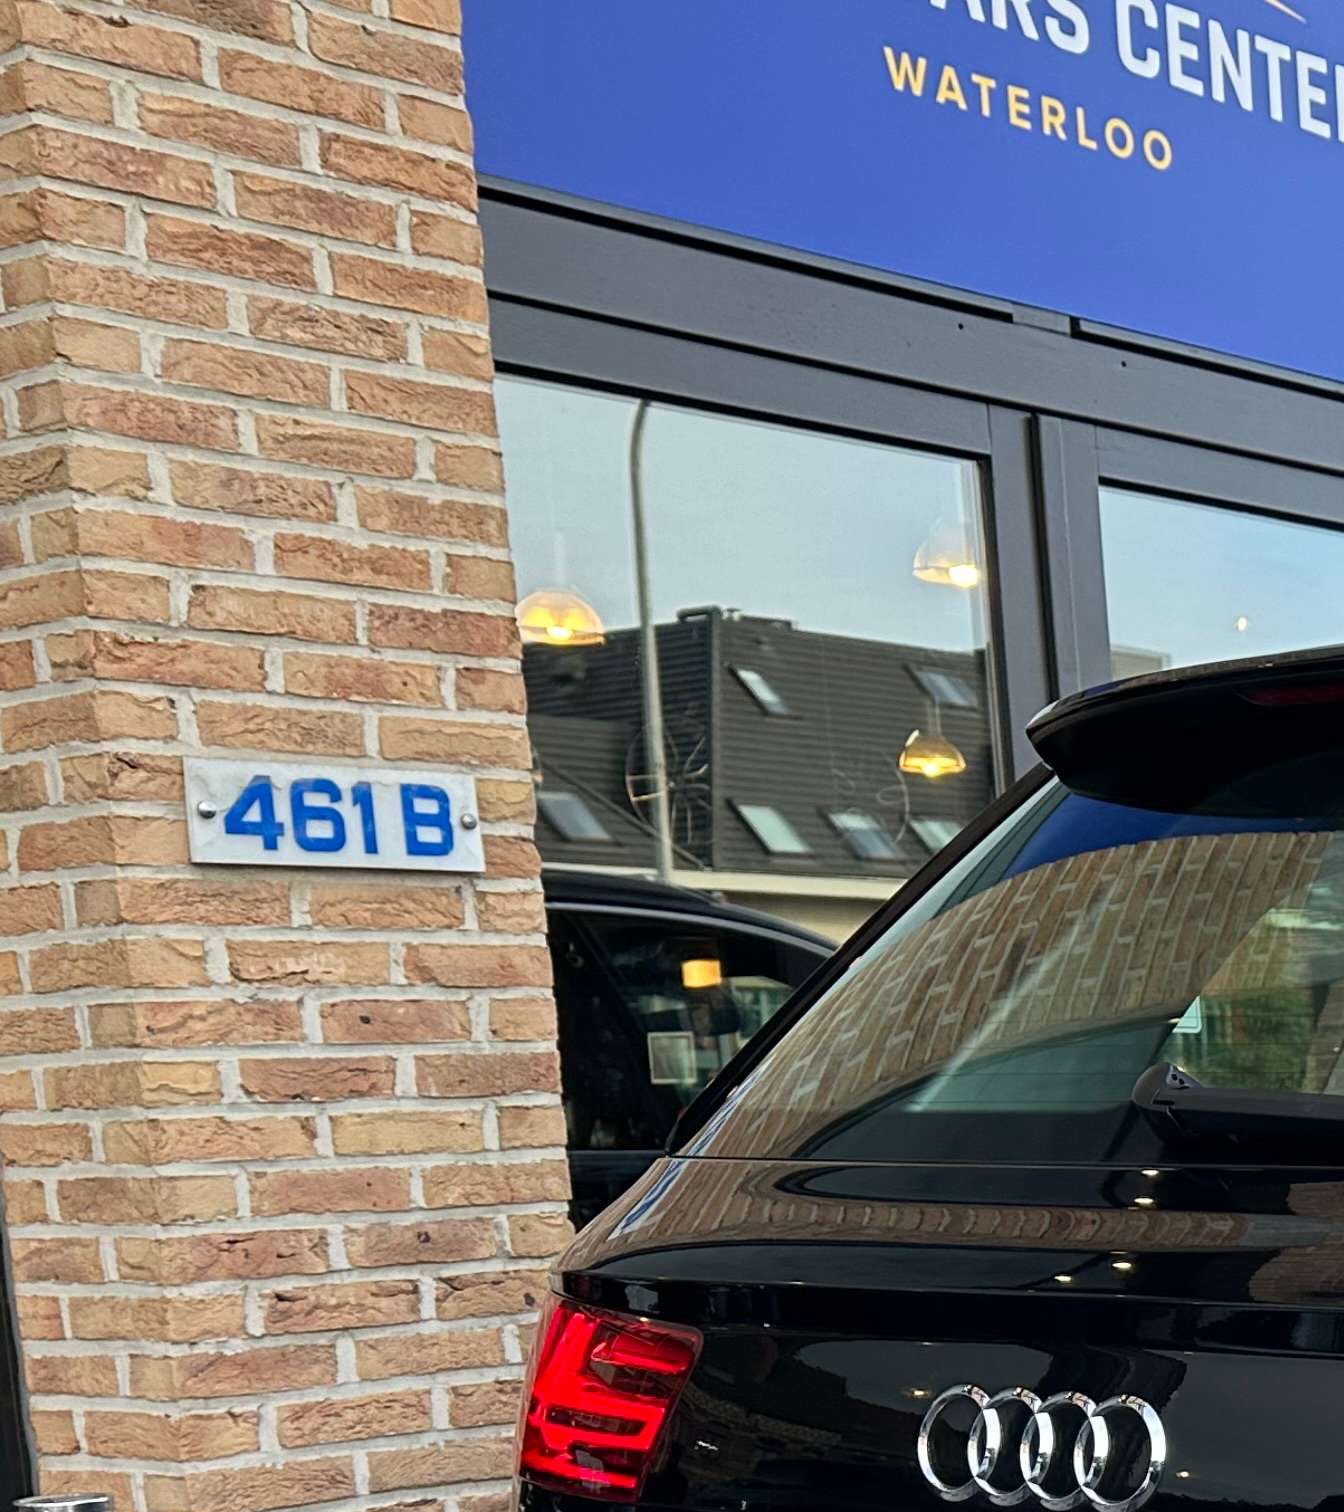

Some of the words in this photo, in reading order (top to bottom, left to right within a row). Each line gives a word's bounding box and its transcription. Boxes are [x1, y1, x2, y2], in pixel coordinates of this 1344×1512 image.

[883, 46, 1173, 171] WATERLOO
[223, 774, 379, 855] 461
[399, 783, 455, 857] B
